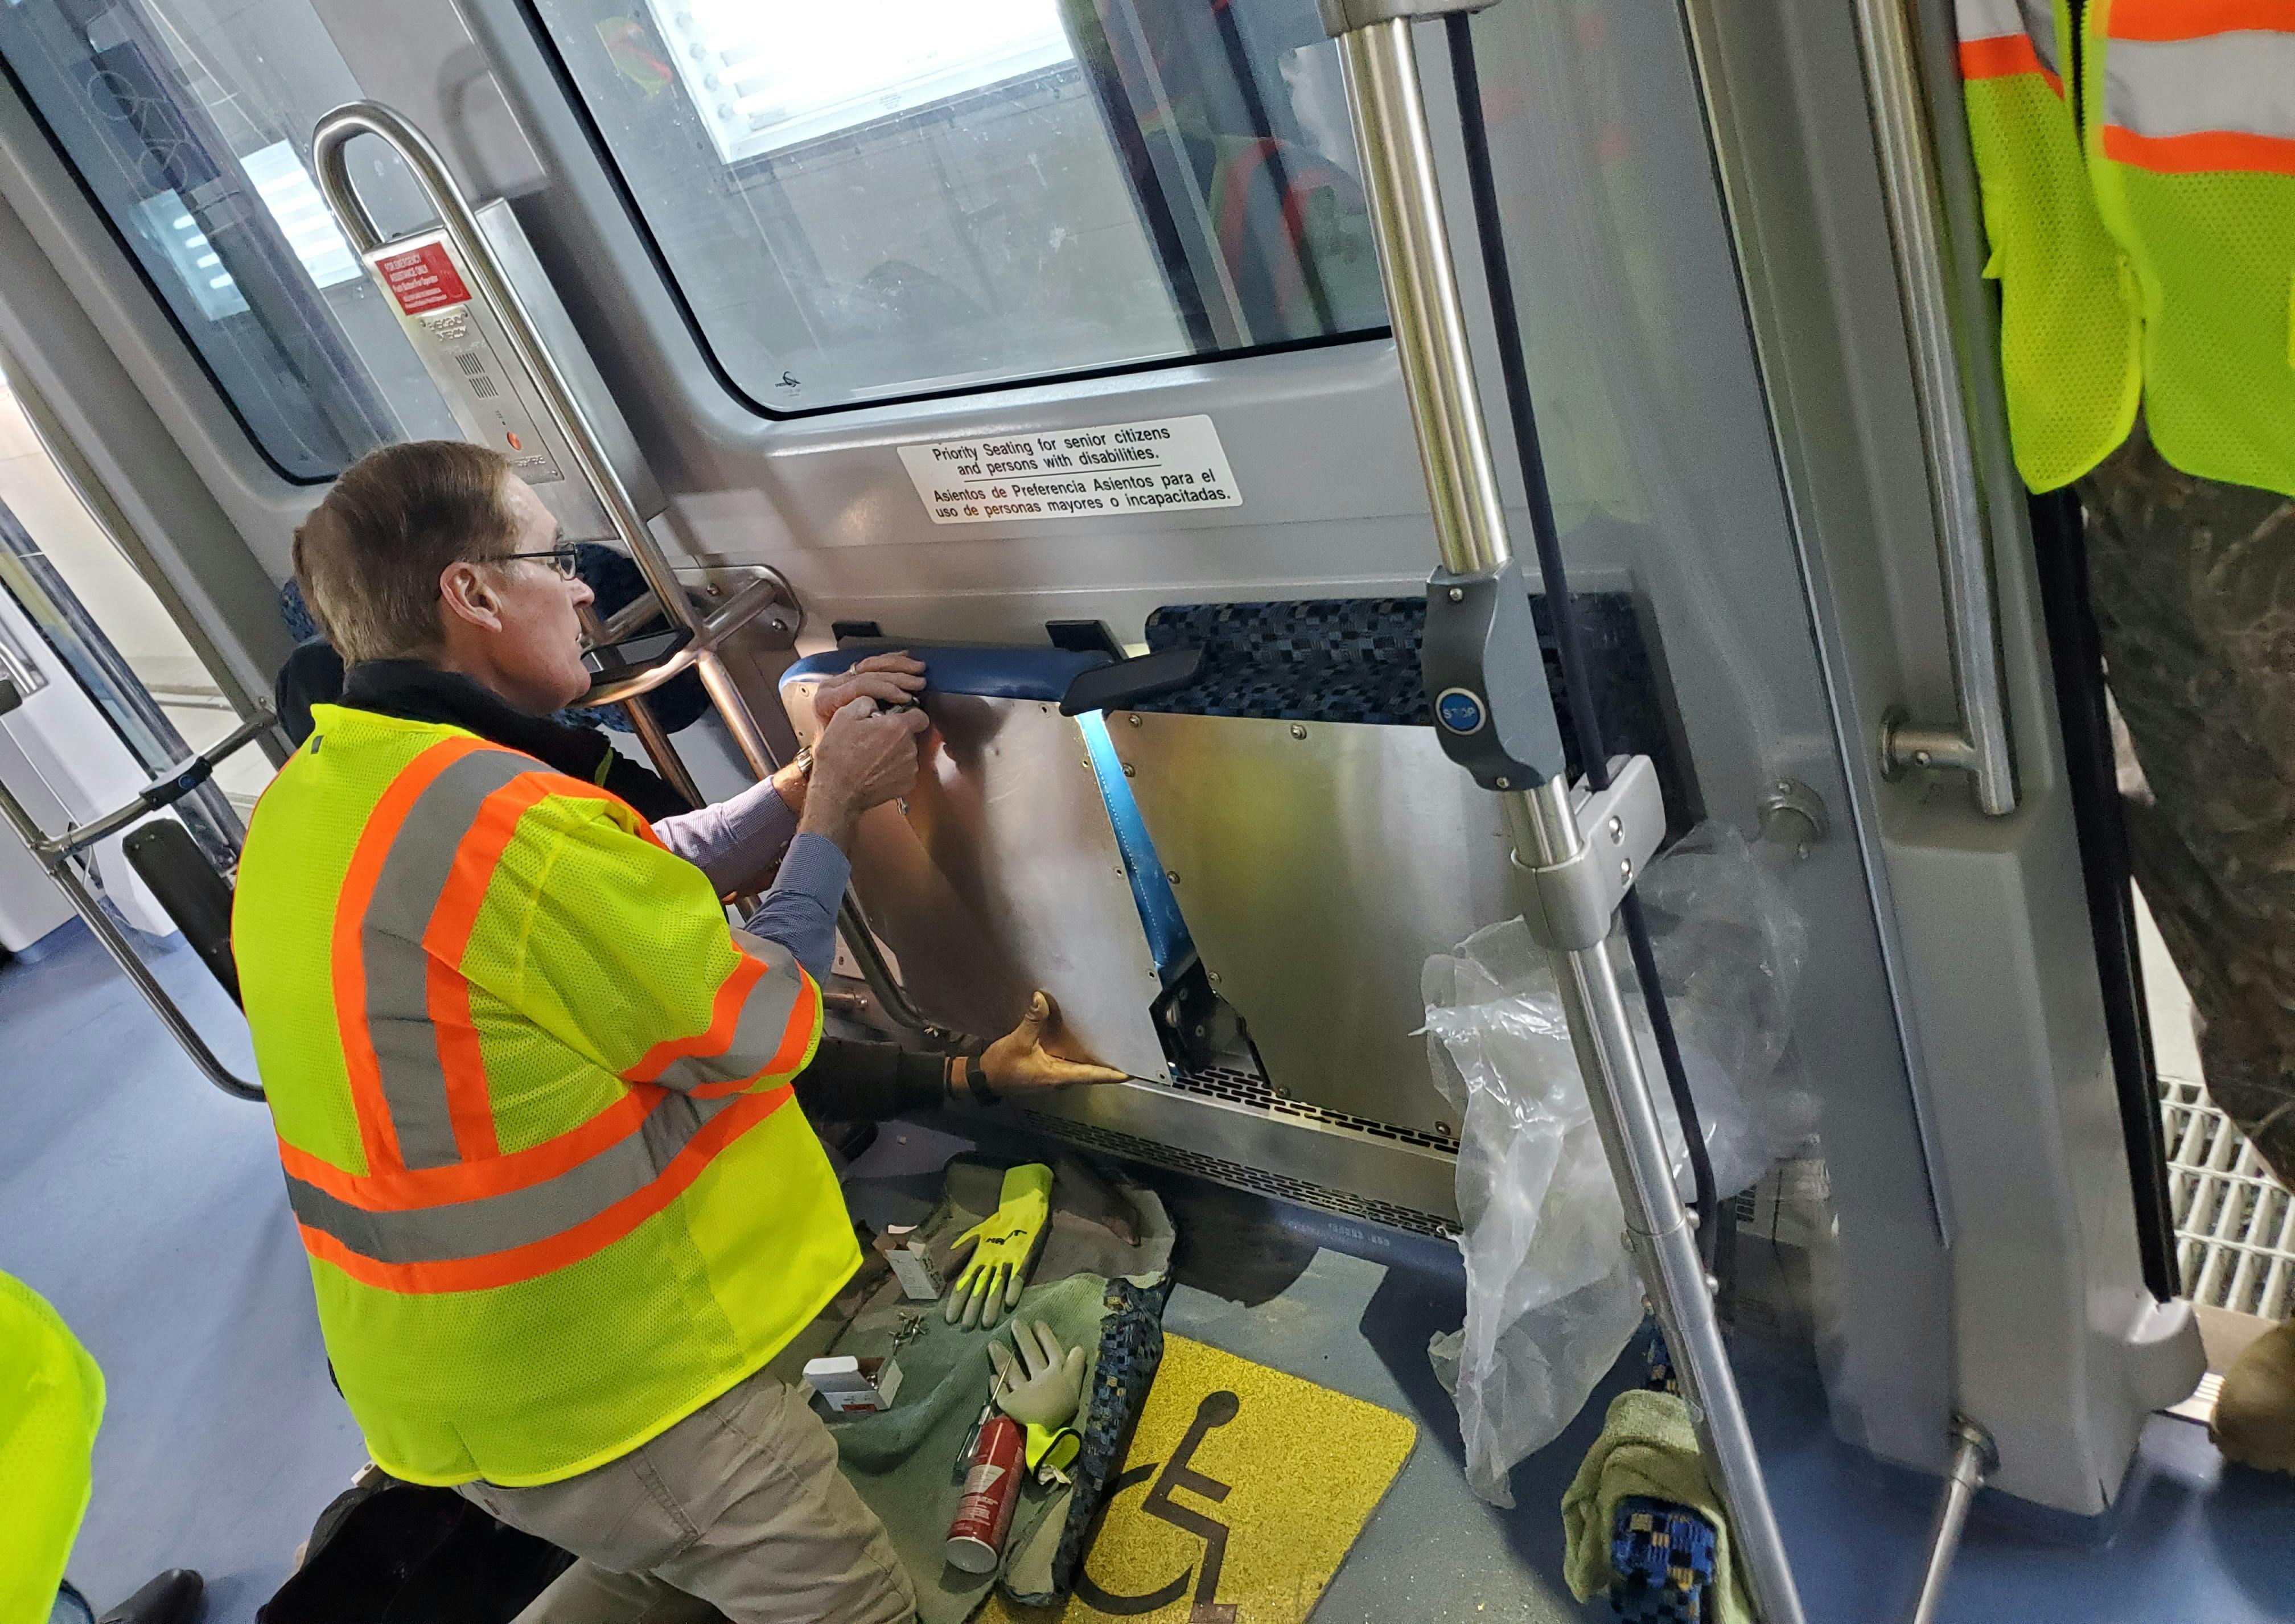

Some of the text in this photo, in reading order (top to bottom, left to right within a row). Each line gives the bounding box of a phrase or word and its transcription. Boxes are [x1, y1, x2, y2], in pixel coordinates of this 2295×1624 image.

[932, 427, 1171, 461] Priority Seating for senior citizens
[957, 447, 1159, 476] and persons with disabilities.
[933, 468, 1216, 503] Asientos de Preferencia Asientos para el
[935, 487, 1231, 518] uso de personas mayores o incapacitadas.
[1442, 706, 1476, 720] STOP
